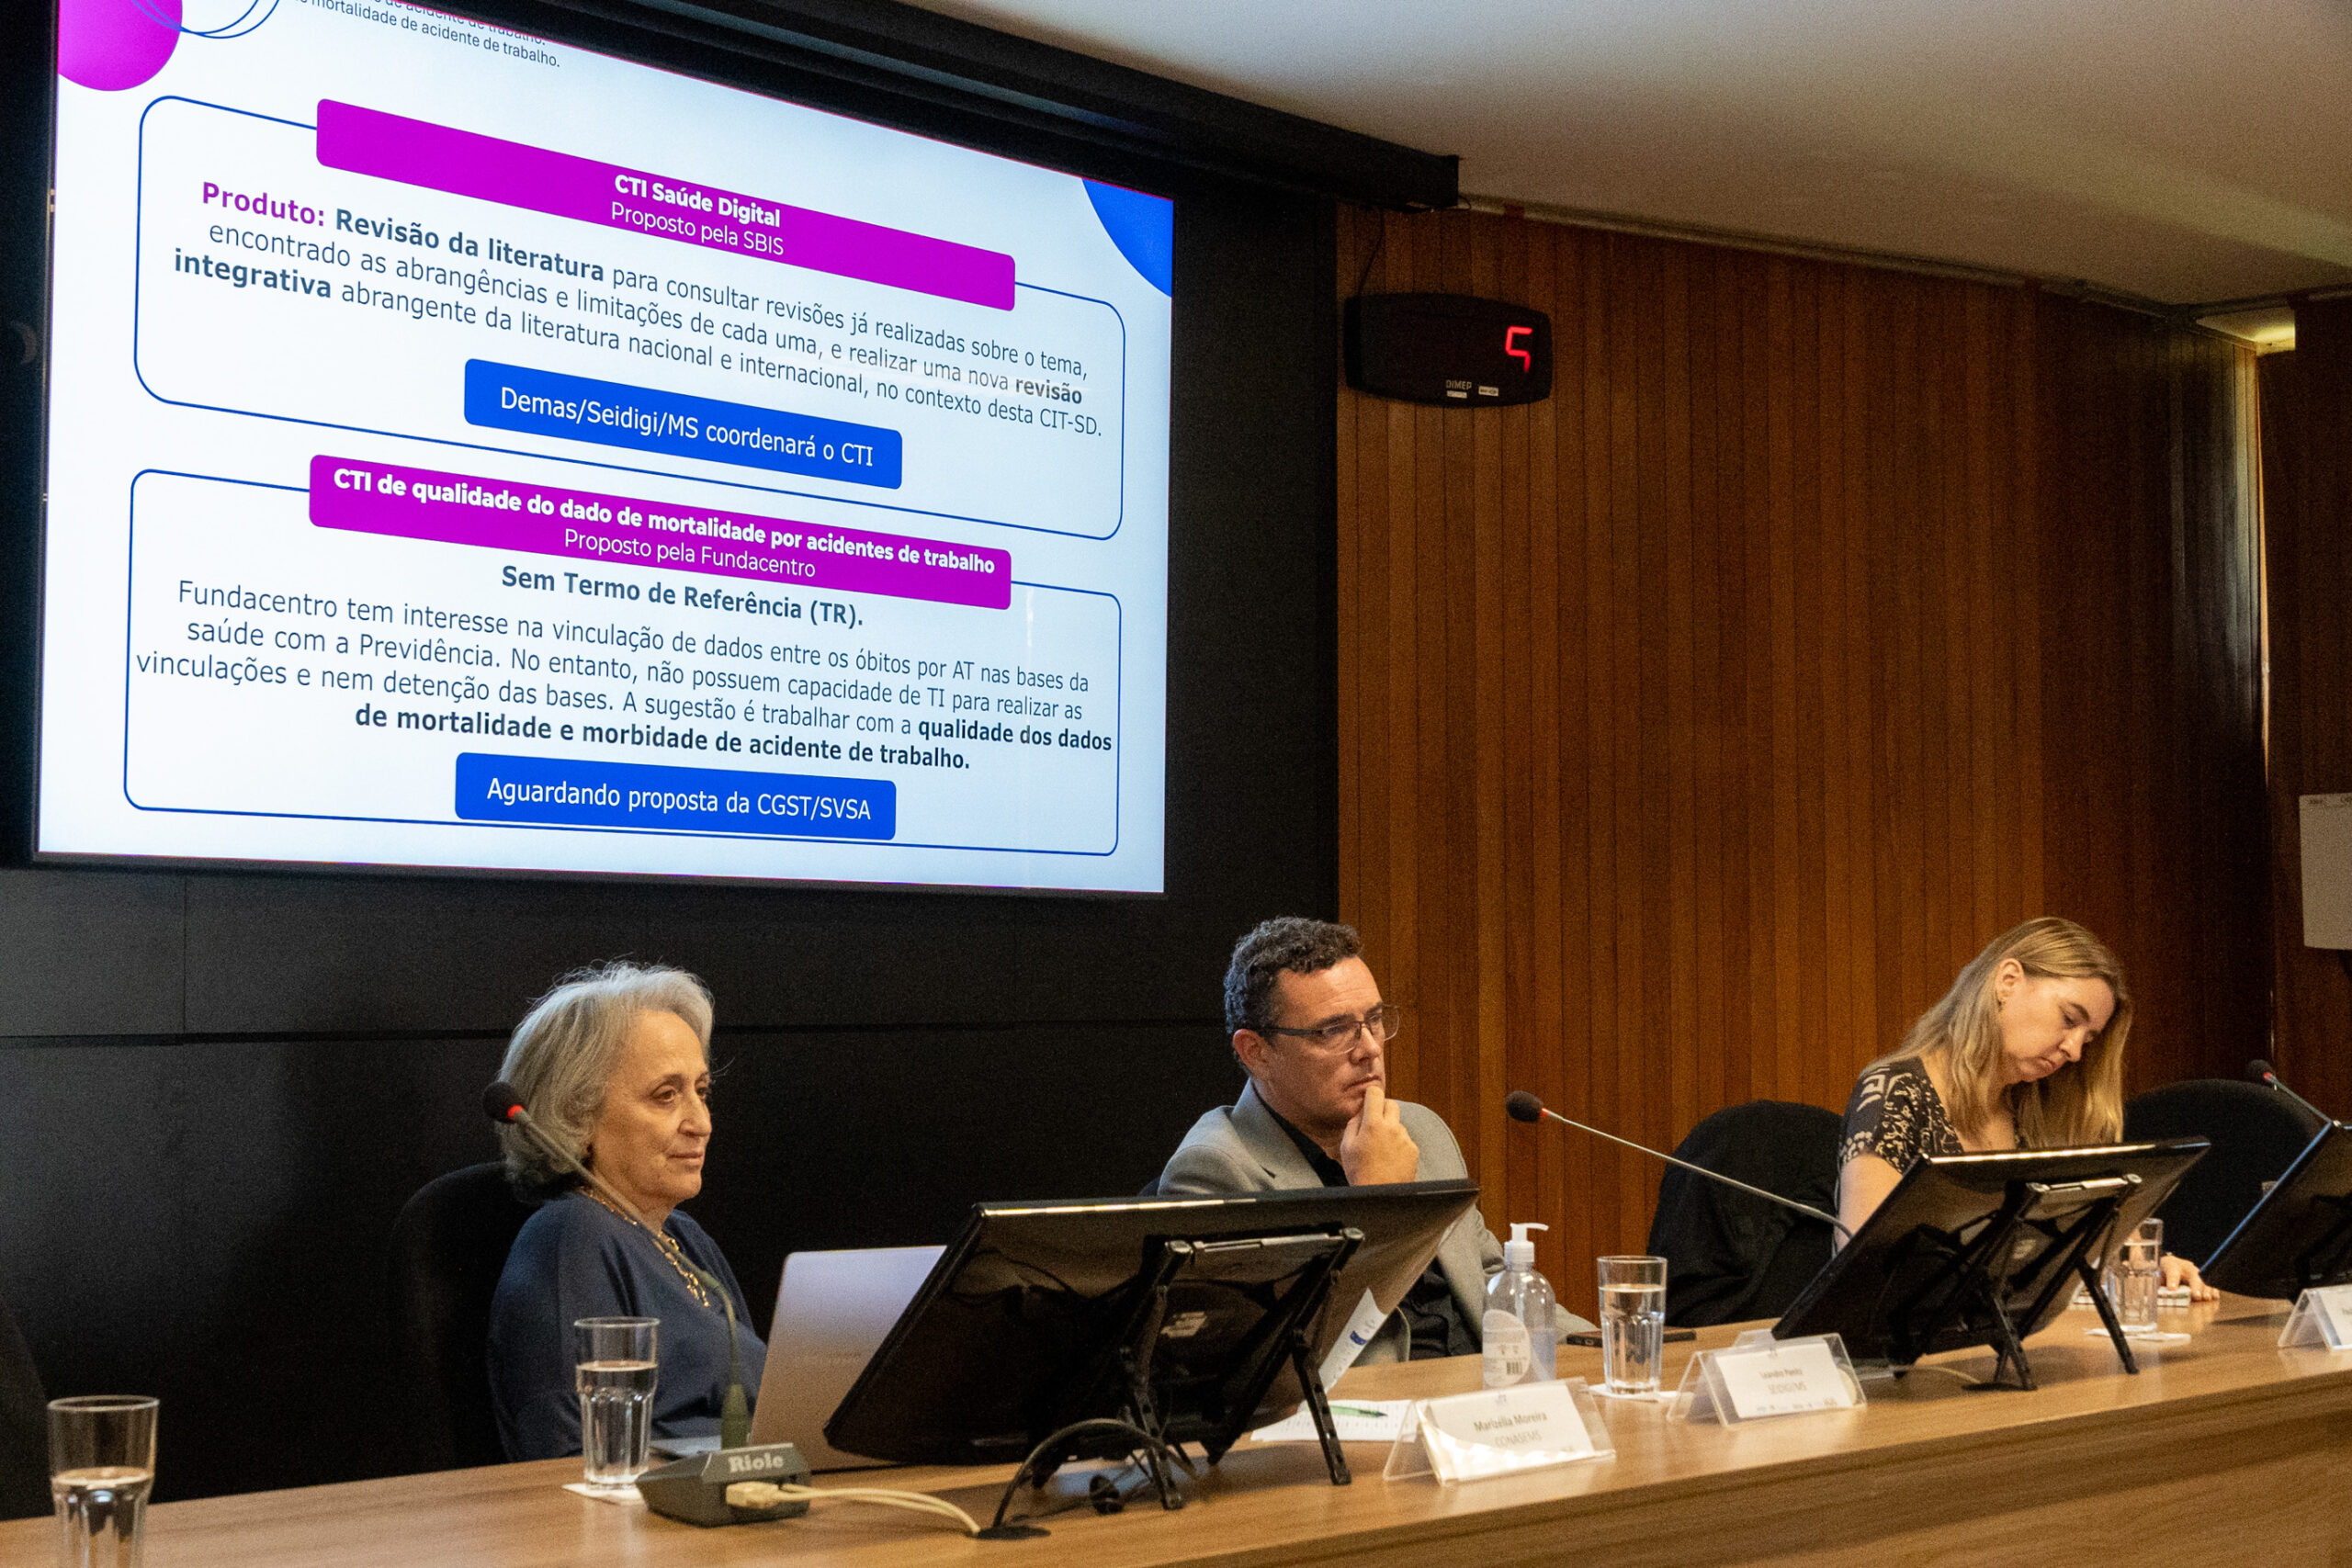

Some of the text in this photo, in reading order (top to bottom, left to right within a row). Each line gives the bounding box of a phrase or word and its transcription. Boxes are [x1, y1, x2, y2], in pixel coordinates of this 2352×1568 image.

[401, 16, 418, 31] de
[422, 23, 480, 47] acidente
[483, 37, 500, 51] de
[503, 41, 560, 67] trabalho.
[612, 201, 784, 255] Proposto pela SBIS
[615, 175, 780, 227] CTI Saúde Digital
[203, 181, 1087, 381] Produto: Revisão da literatura para consultar revisões já realizadas sobre o tema,
[209, 225, 1082, 404] encontrado as abrangências e limitações de cada uma, e realizar uma nova revisão
[175, 247, 1102, 436] integrativa abrangente da literatura nacional e internacional, no contexto desta CIT-SD.
[502, 387, 873, 466] Demas/Seidigi/MS coordenará o CTI
[334, 468, 995, 573] CTI de qualidade do dado de mortalidade por acidentes de trabalho
[565, 528, 815, 577] Proposto pela Fundacentro
[502, 565, 863, 629] Sem Termo de Referência (TR).
[179, 580, 1088, 692] Fundacentro tem interesse na vinculação de dados entre os óbitos por AT nas bases da
[187, 617, 1082, 720] saúde com a Previdência. No entanto, não possuem capacidade de TI para realizar as
[136, 650, 1112, 750] vinculações e nem detenção das bases. A sugestão é trabalhar com a qualidade dos dados
[356, 703, 969, 769] de mortalidade e morbidade de acidente de trabalho.
[487, 778, 871, 820] Aguardando proposta da CGST/SVSA
[728, 1452, 785, 1473] Riole
